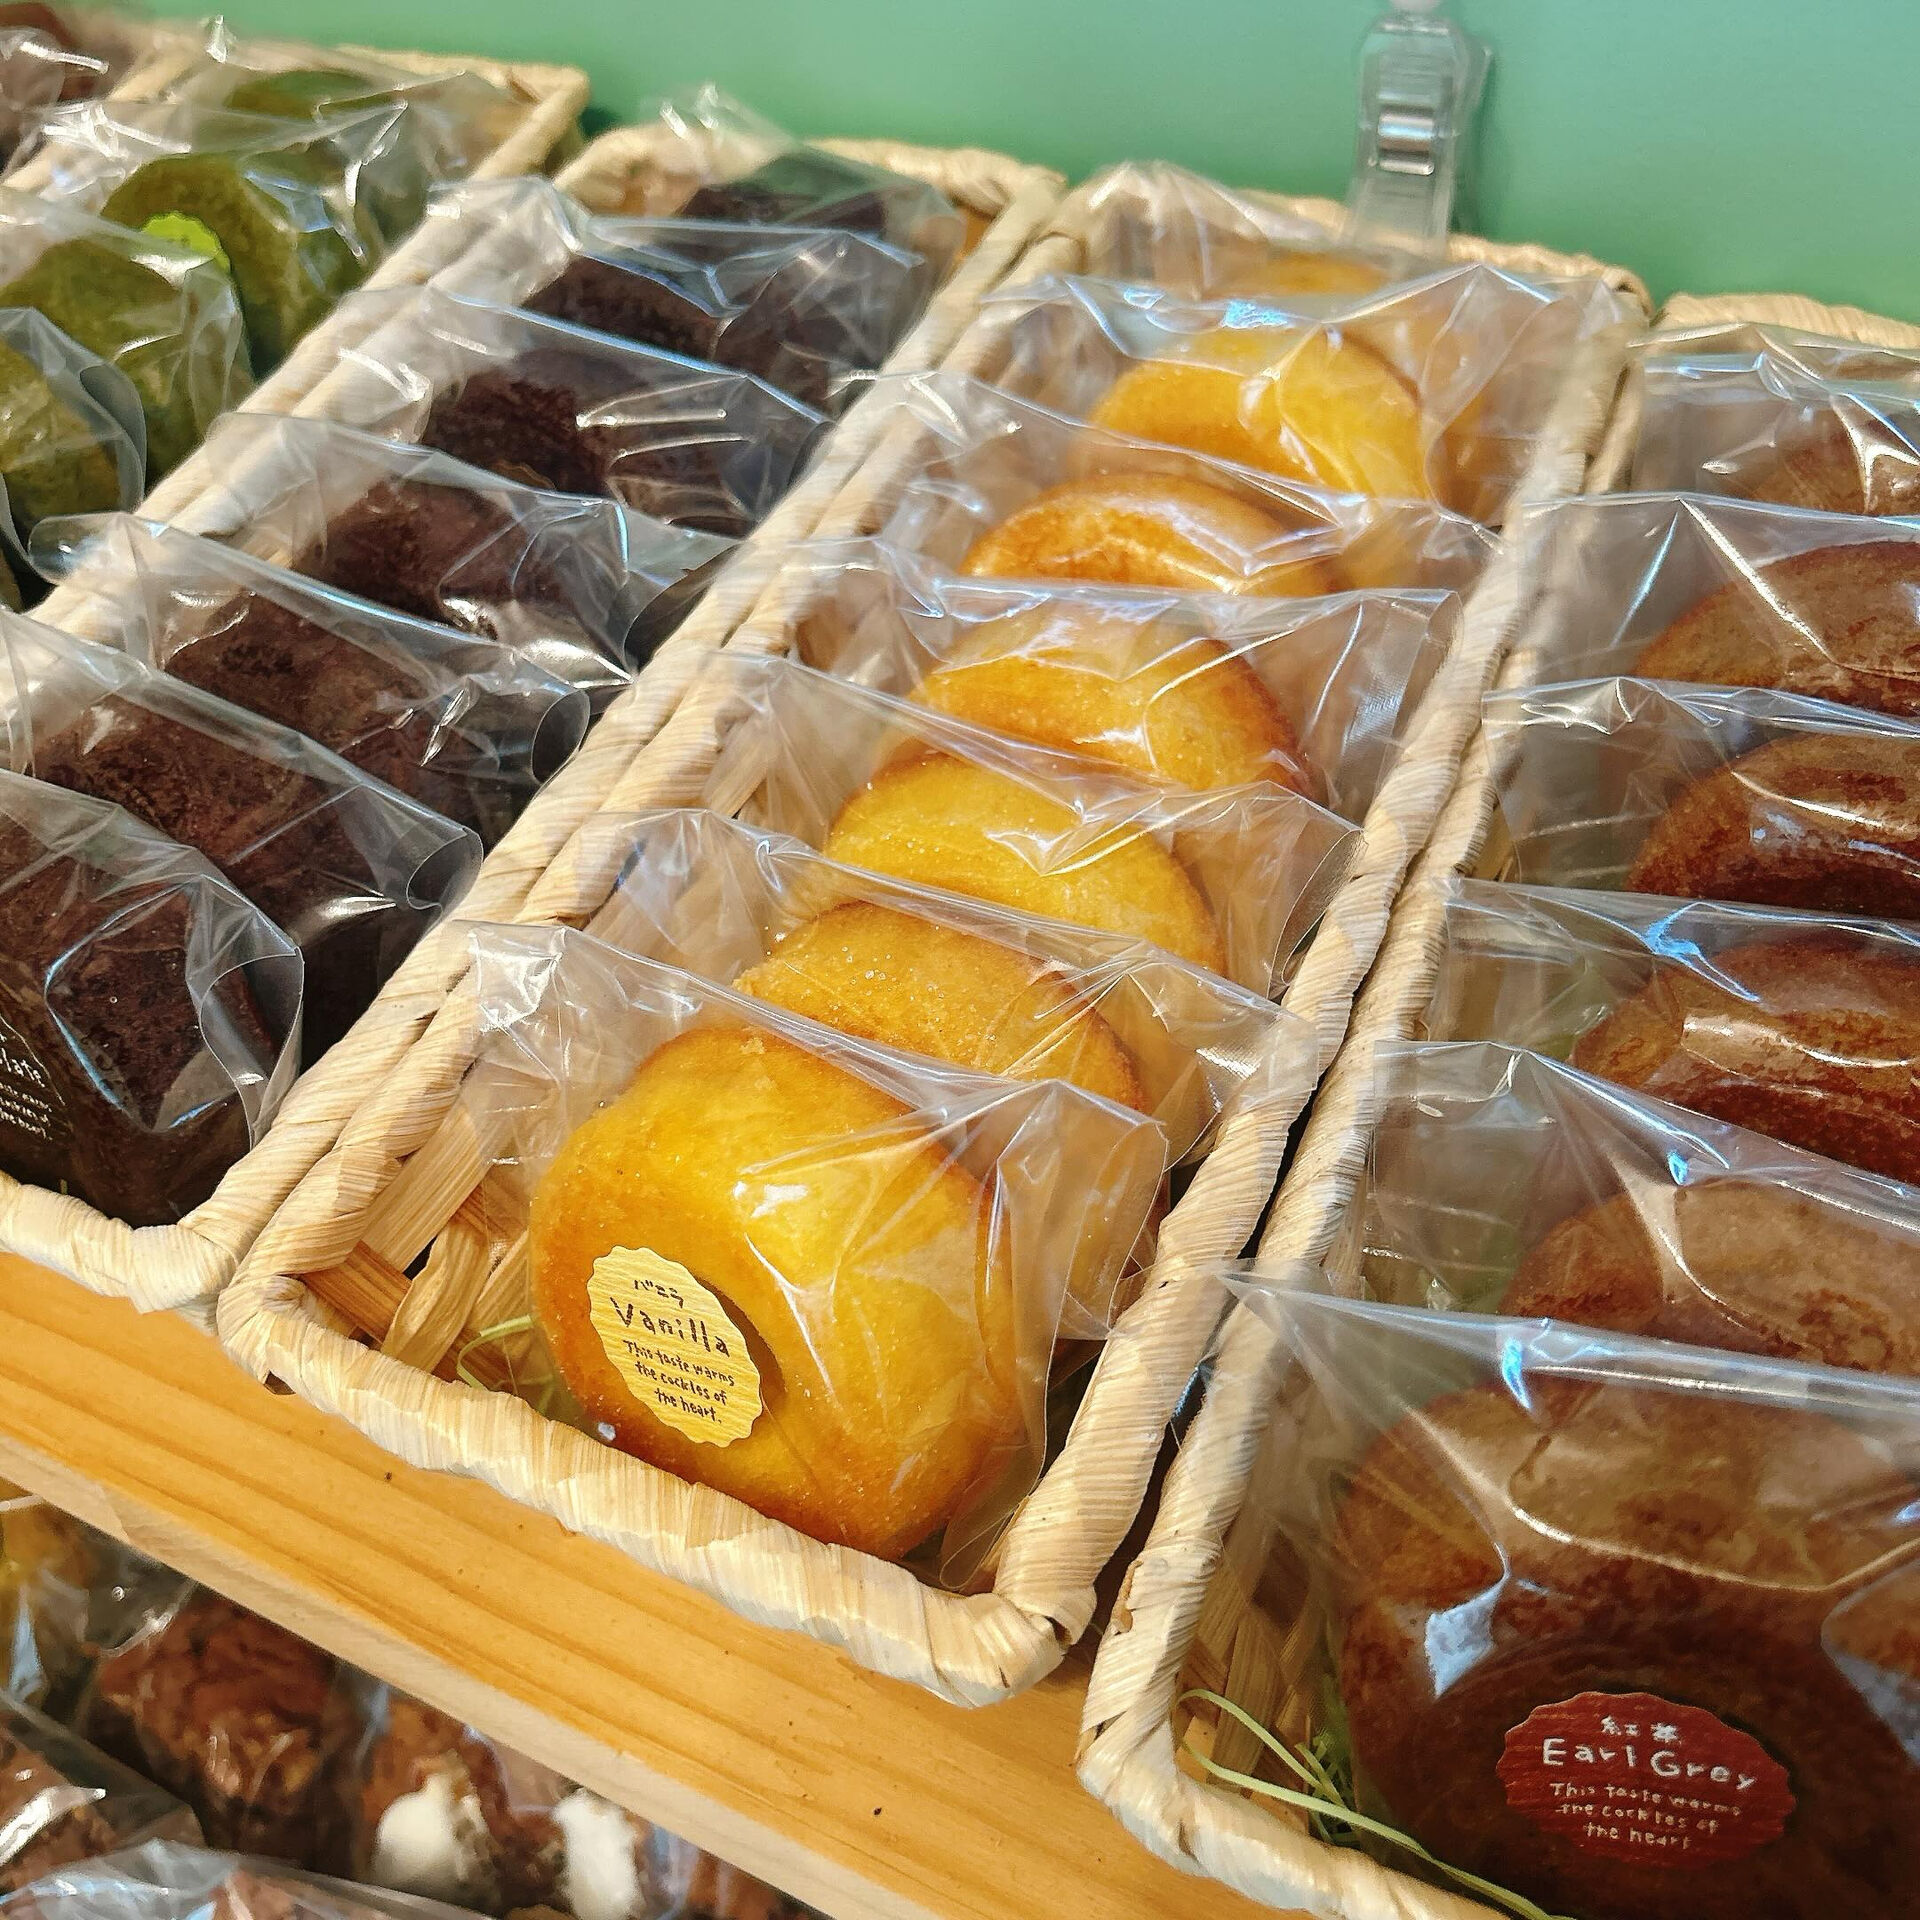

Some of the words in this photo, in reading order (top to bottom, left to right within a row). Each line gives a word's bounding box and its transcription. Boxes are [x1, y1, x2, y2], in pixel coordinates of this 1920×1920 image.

[0, 1047, 46, 1088] late
[633, 1279, 684, 1309] バニラ
[609, 1296, 730, 1358] Vanilla
[622, 1339, 654, 1360] This
[655, 1350, 690, 1373] taste
[692, 1363, 735, 1387] warms
[634, 1360, 658, 1381] the
[660, 1373, 711, 1400] cockles
[713, 1390, 728, 1405] of
[653, 1387, 678, 1408] the
[1542, 1737, 1637, 1768] Earl
[1649, 1749, 1757, 1792] Grey
[1549, 1782, 1596, 1798] This
[1605, 1783, 1663, 1804] taste
[1668, 1794, 1742, 1816] warms
[1582, 1821, 1620, 1840] the
